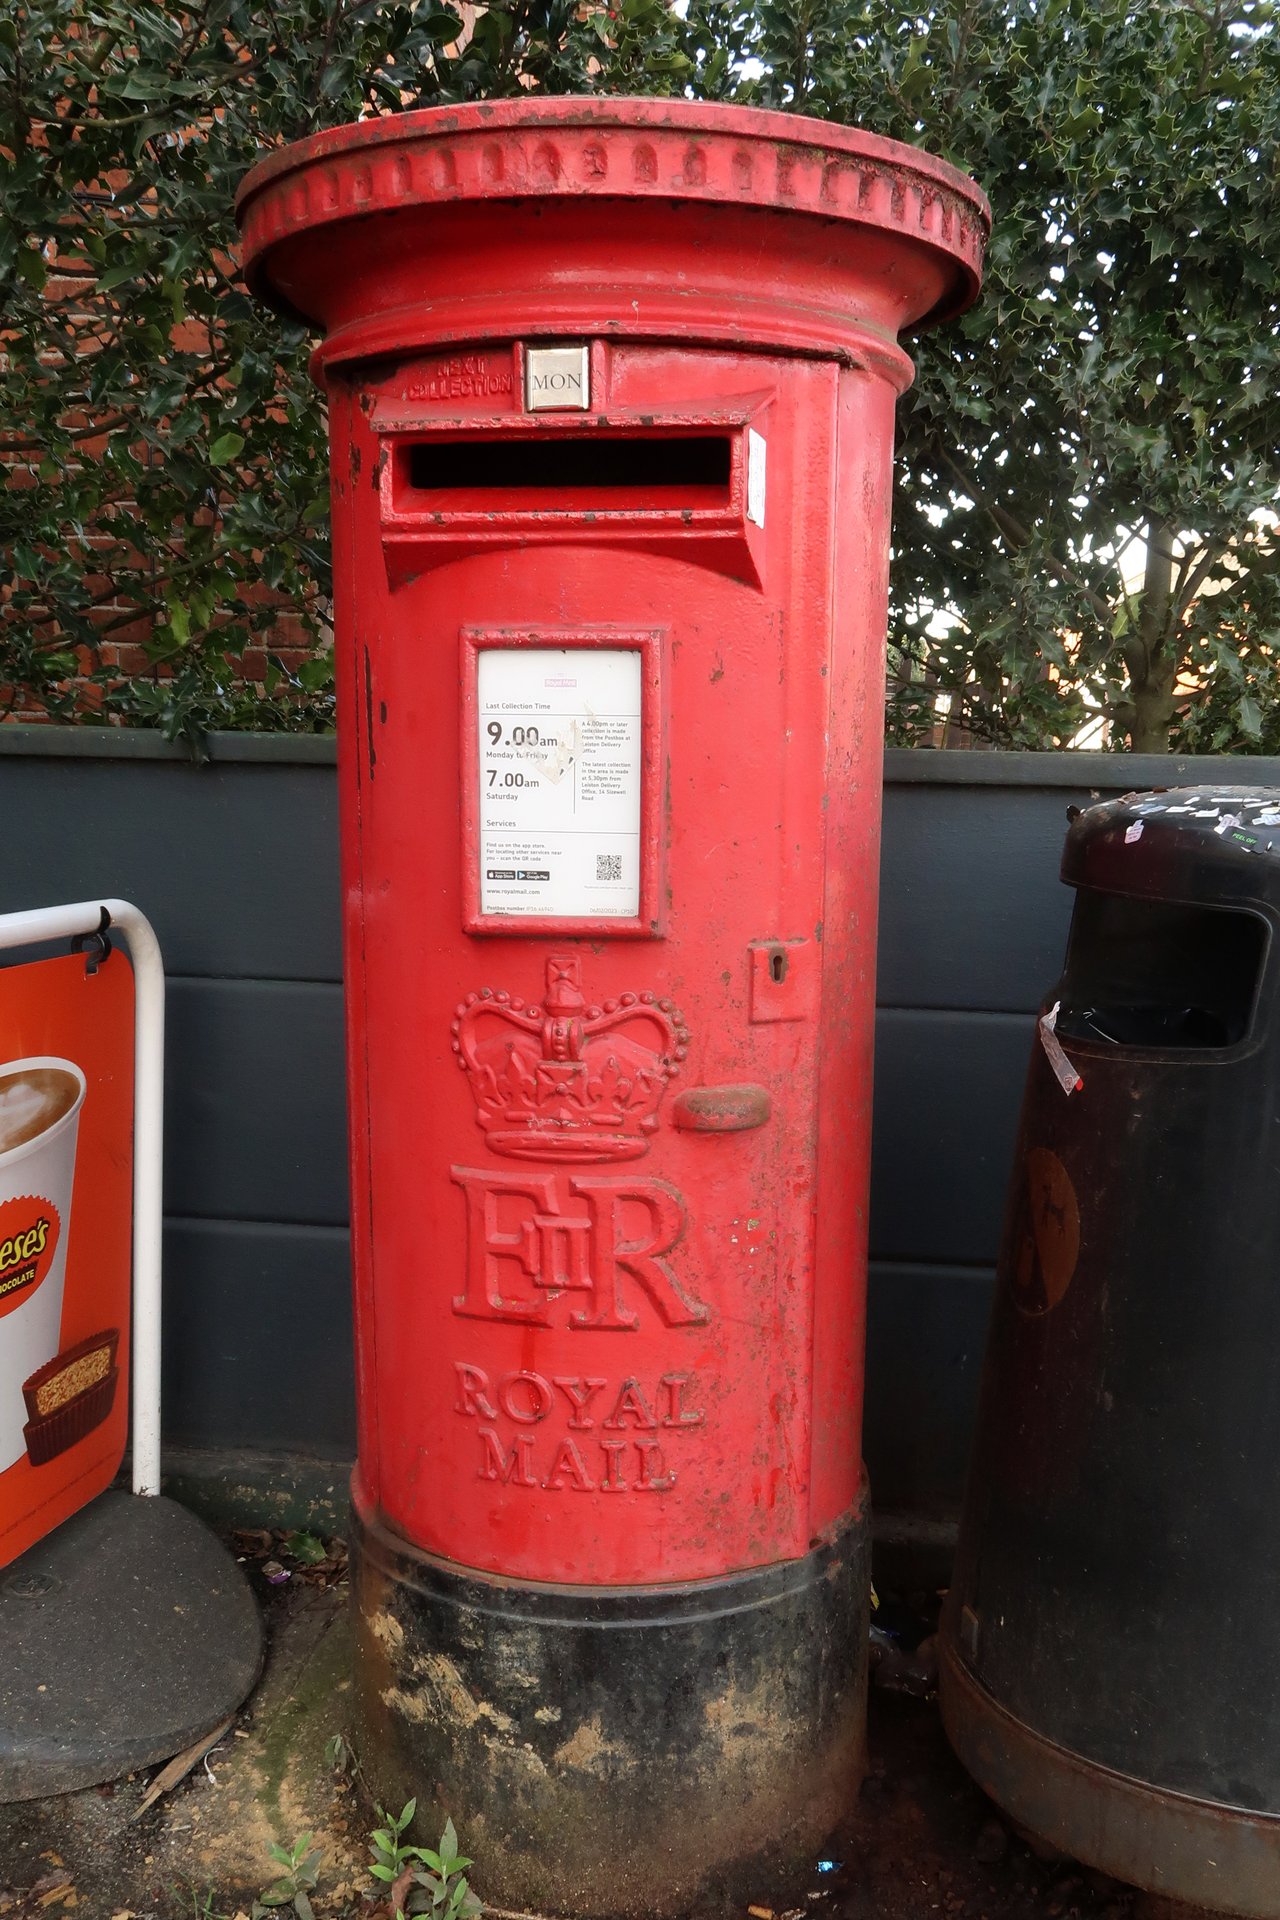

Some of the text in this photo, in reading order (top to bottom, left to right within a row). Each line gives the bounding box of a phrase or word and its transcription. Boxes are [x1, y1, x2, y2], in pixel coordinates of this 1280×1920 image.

[409, 374, 514, 400] COLLECTION
[532, 373, 582, 390] MON
[487, 721, 558, 746] 9.00am
[486, 752, 514, 760] Monday
[486, 770, 540, 787] 7.00am
[486, 792, 518, 801] Saturday
[454, 1361, 706, 1430] ROYAL
[477, 1427, 678, 1492] MAIL
